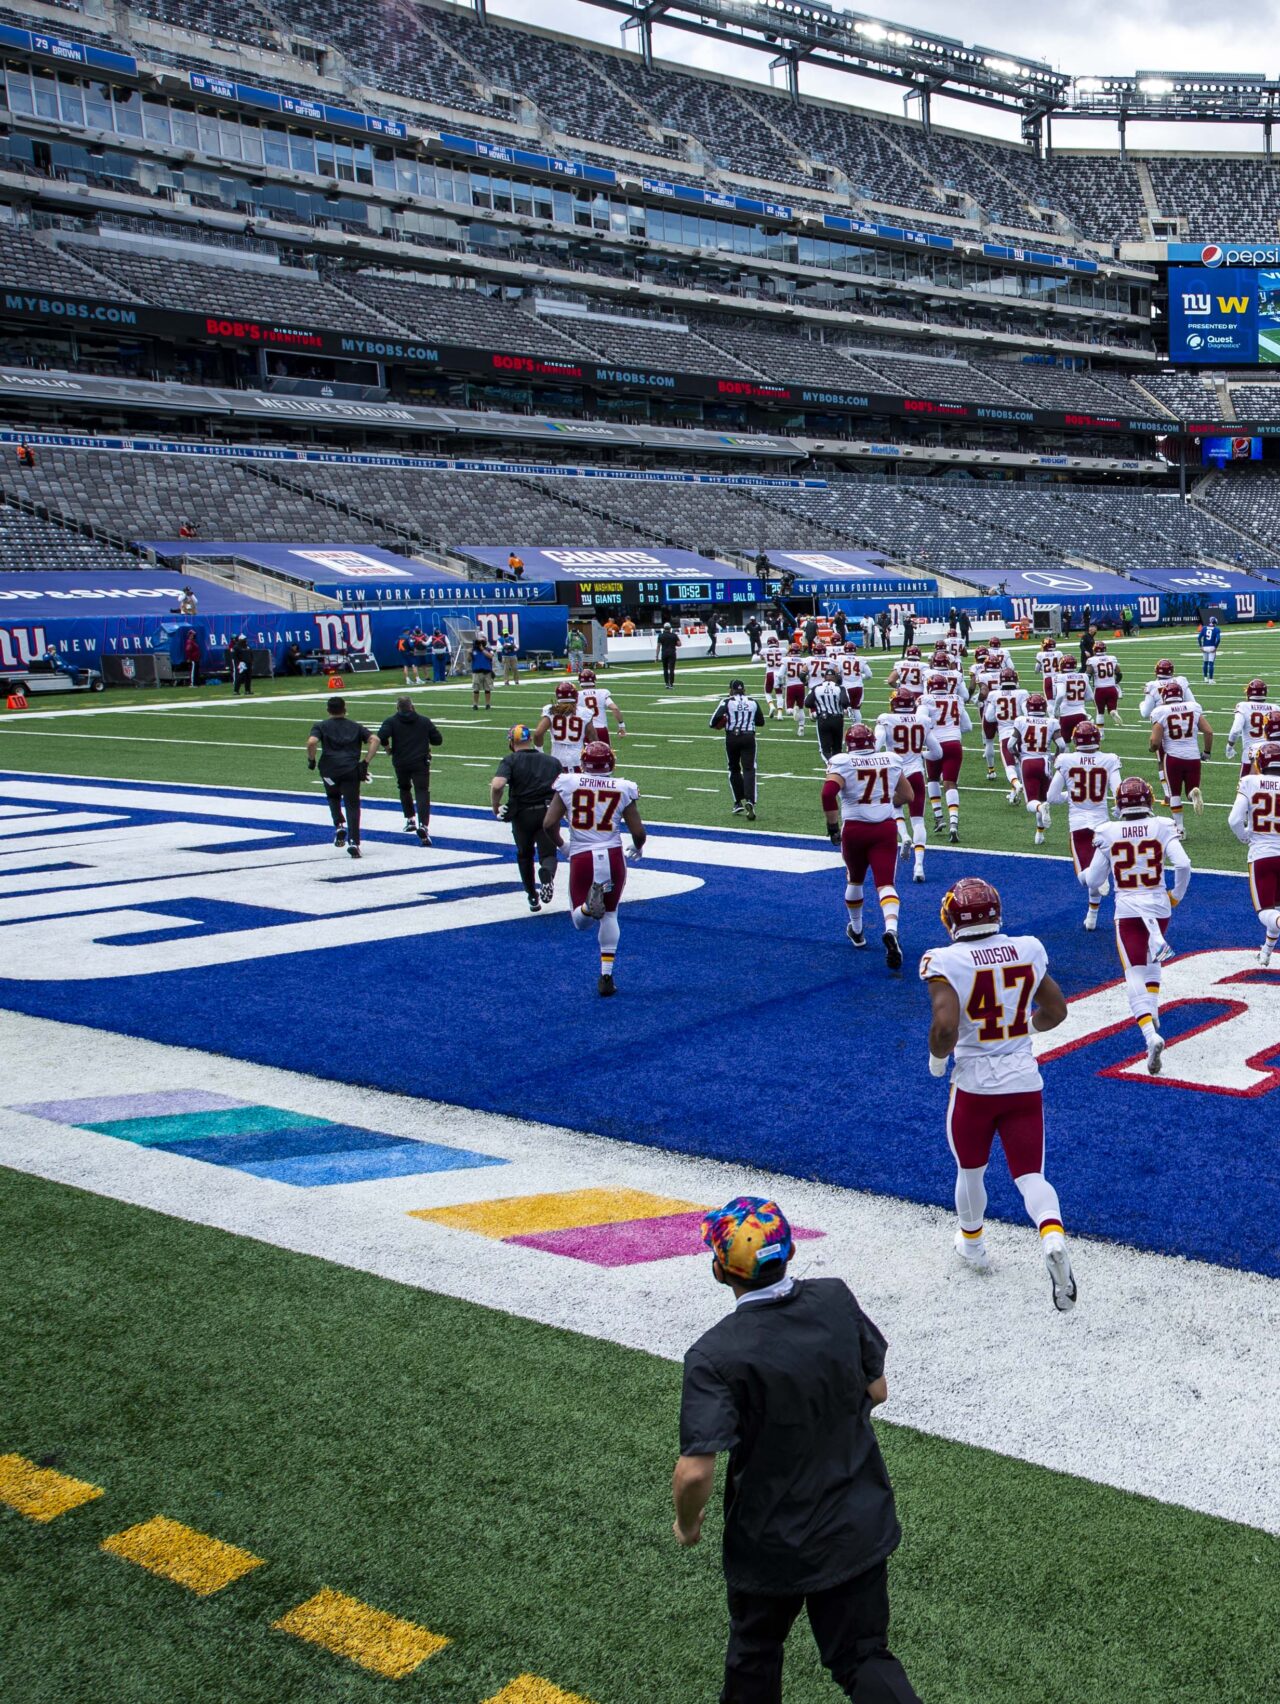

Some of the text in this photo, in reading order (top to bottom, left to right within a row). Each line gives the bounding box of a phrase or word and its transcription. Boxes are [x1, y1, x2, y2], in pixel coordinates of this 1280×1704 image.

[35, 37, 48, 50] 79
[52, 45, 81, 61] BROWN
[211, 84, 231, 97] MARA
[295, 106, 321, 118] GIFFORD
[384, 126, 401, 137] TISCH
[489, 150, 511, 162] HOWELL
[651, 186, 673, 196] WEBSTER
[1226, 248, 1279, 266] pepsi
[5, 294, 137, 325] MYBOBS.COM
[1182, 293, 1249, 315] ny W
[206, 318, 260, 340] BOB'S
[273, 327, 313, 337] DISCOUNT
[263, 331, 323, 347] FURNITURE
[1207, 335, 1233, 344] Quest
[341, 338, 438, 362] MYBOBS.COM
[493, 354, 534, 373] BOB'S
[2, 374, 82, 391] MetLife
[596, 369, 675, 388] MYBOBS.COM
[718, 380, 751, 395] BOB'S
[803, 391, 869, 407] MYBOBS.COM
[904, 400, 933, 412] BOB'S
[254, 396, 415, 422] METLIFE STADIUM
[977, 408, 1034, 421] MYBOBS.COM
[1065, 414, 1092, 425] BOB'S
[1129, 421, 1180, 433] MYBOBS.COM
[566, 425, 613, 436] MetLife
[735, 437, 779, 448] MetLife
[870, 444, 900, 456] MetLife
[1040, 457, 1067, 466] BUD LIGHT
[540, 551, 661, 564] GIANTS
[337, 586, 539, 600] NEW YORK FOOTBALL GIANTS
[594, 583, 624, 592] WASHINGTON
[678, 585, 701, 598] 10:52
[799, 582, 928, 592] NEW YORK FOOTBALL GIANTS
[581, 593, 622, 606] ny GIANTS
[733, 592, 756, 602] BALL ON
[1138, 596, 1160, 622] ny
[1235, 594, 1255, 618] ny
[258, 630, 311, 644] GIANTS
[315, 614, 370, 652] ny
[1205, 630, 1214, 640] 9
[60, 636, 154, 652] NEW YORK
[766, 653, 783, 668] 55
[842, 660, 861, 676] 94
[1042, 657, 1060, 674] 24
[811, 660, 831, 678] 75
[900, 667, 922, 686] 73
[1097, 662, 1114, 679] 60
[332, 677, 343, 687] 20
[1065, 680, 1087, 702] 52
[13, 696, 26, 708] 10
[737, 703, 749, 712] 82
[996, 696, 1017, 721] 31
[1170, 704, 1188, 713] MARTIN
[899, 715, 917, 724] SWEAT
[935, 700, 961, 727] 74
[550, 712, 584, 743] 99
[1166, 711, 1195, 740] 67
[892, 724, 925, 754] 90
[1023, 725, 1049, 753] 41
[850, 756, 891, 768] SCHWEITZER
[1079, 756, 1097, 766] APKE
[578, 776, 617, 790] SPRINKLE
[857, 767, 891, 804] 71
[1068, 767, 1108, 803] 30
[570, 789, 622, 832] 87
[1121, 824, 1149, 839] DARBY
[1110, 838, 1163, 889] 23
[970, 945, 1020, 967] HUDSON
[965, 963, 1036, 1042] 47
